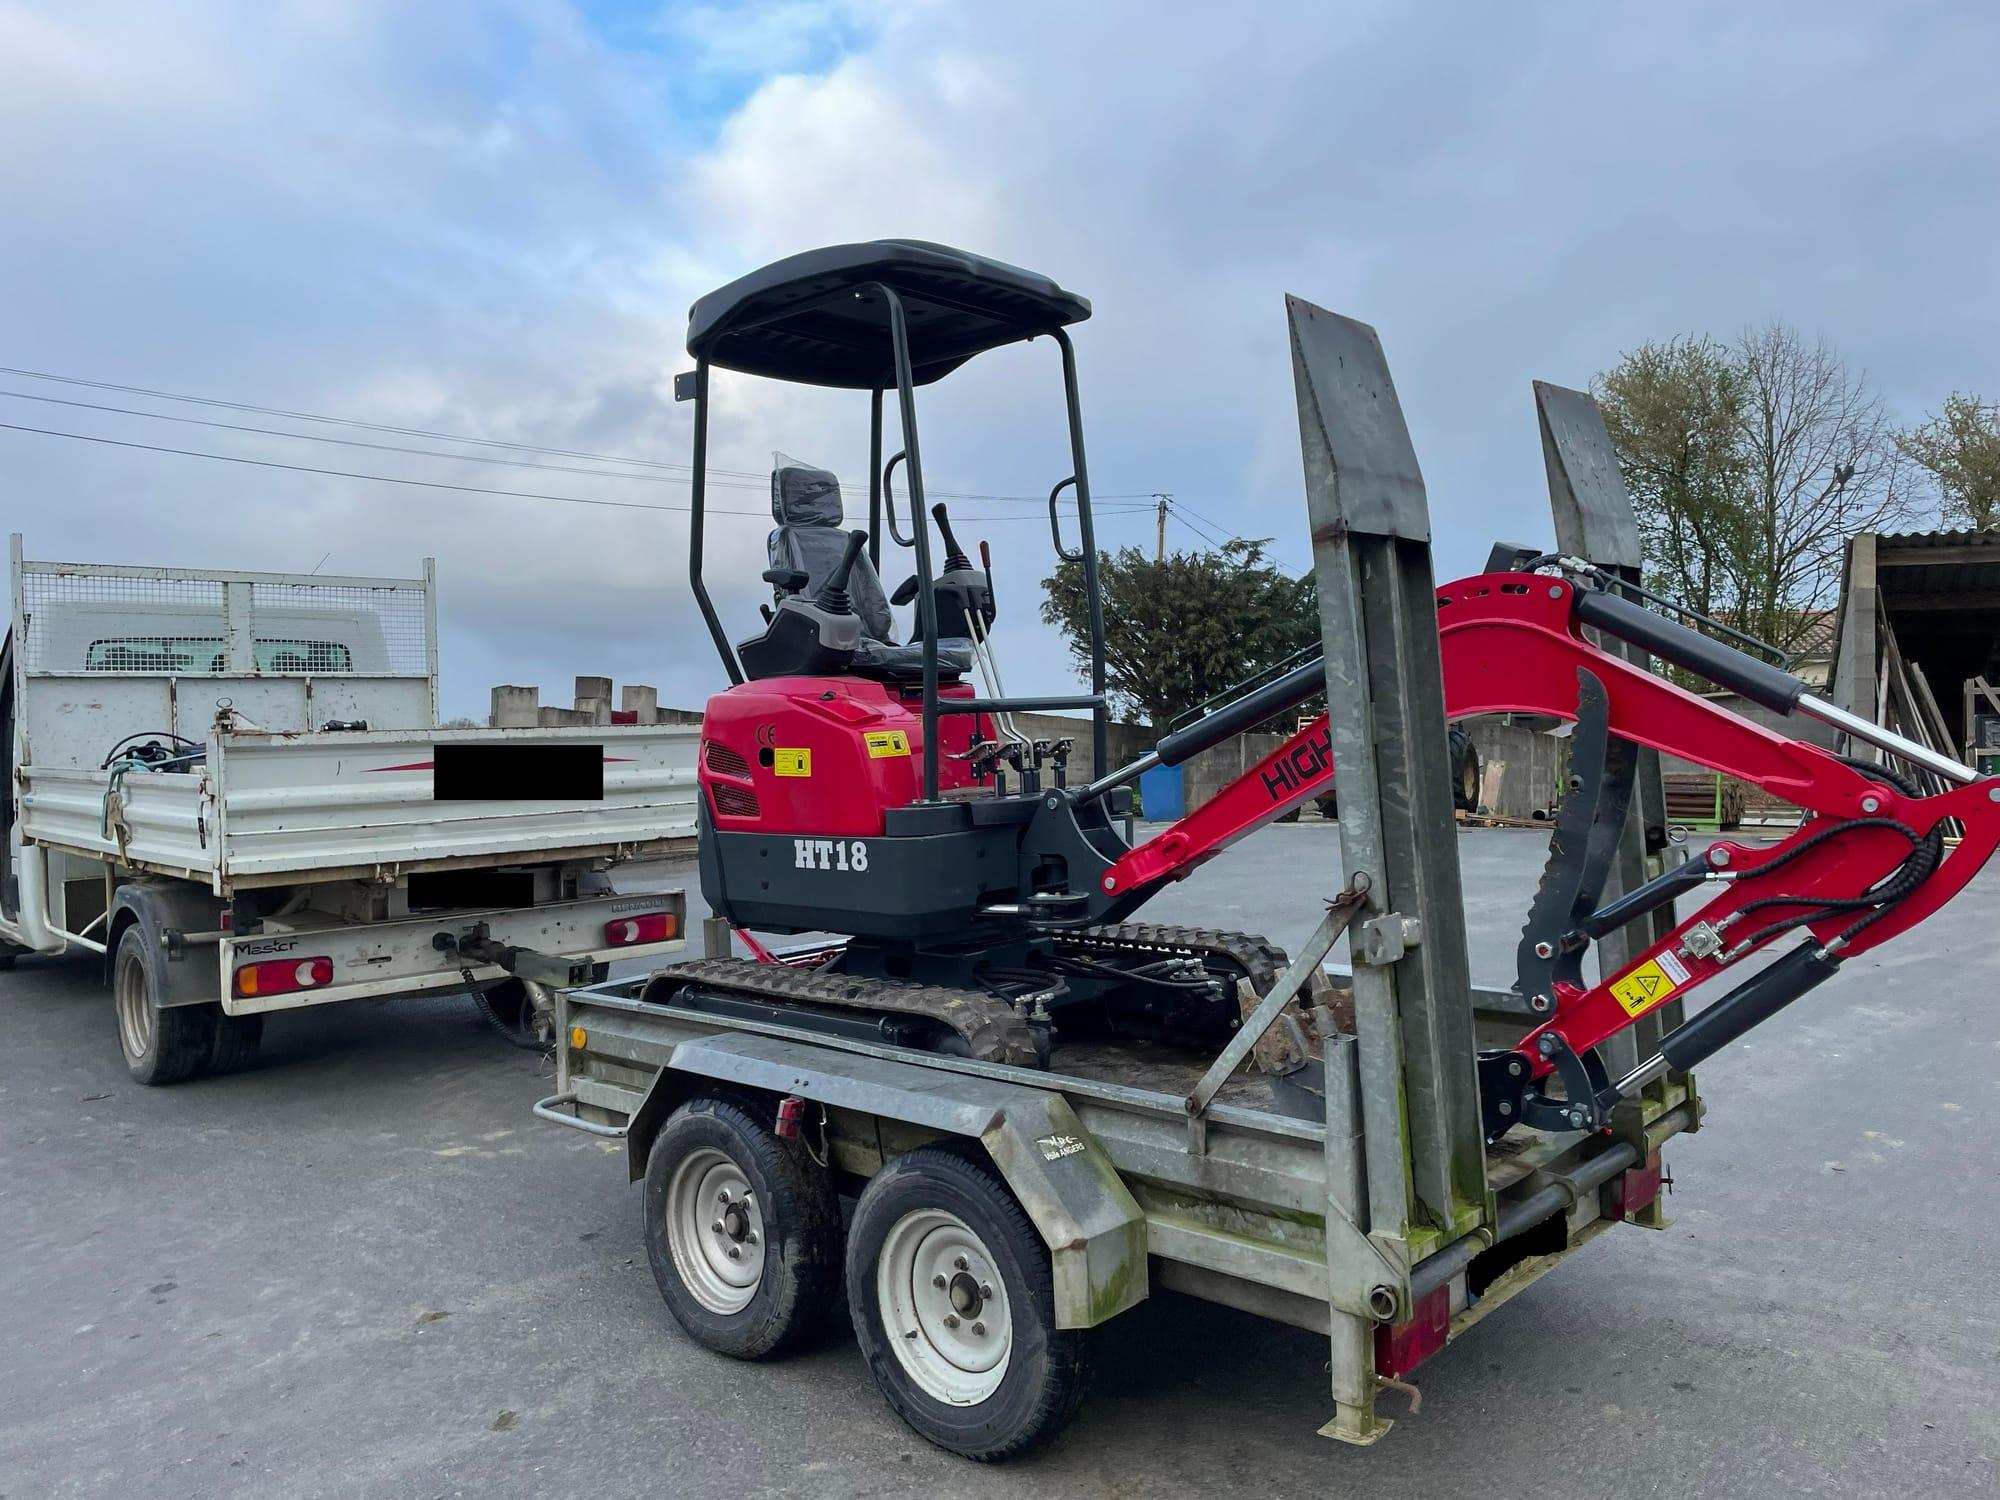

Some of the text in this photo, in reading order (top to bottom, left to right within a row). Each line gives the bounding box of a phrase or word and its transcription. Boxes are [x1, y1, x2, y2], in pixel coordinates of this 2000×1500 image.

[755, 723, 776, 745] CE
[1260, 728, 1332, 801] HIGH
[794, 839, 868, 872] HT18
[234, 939, 299, 958] Master
